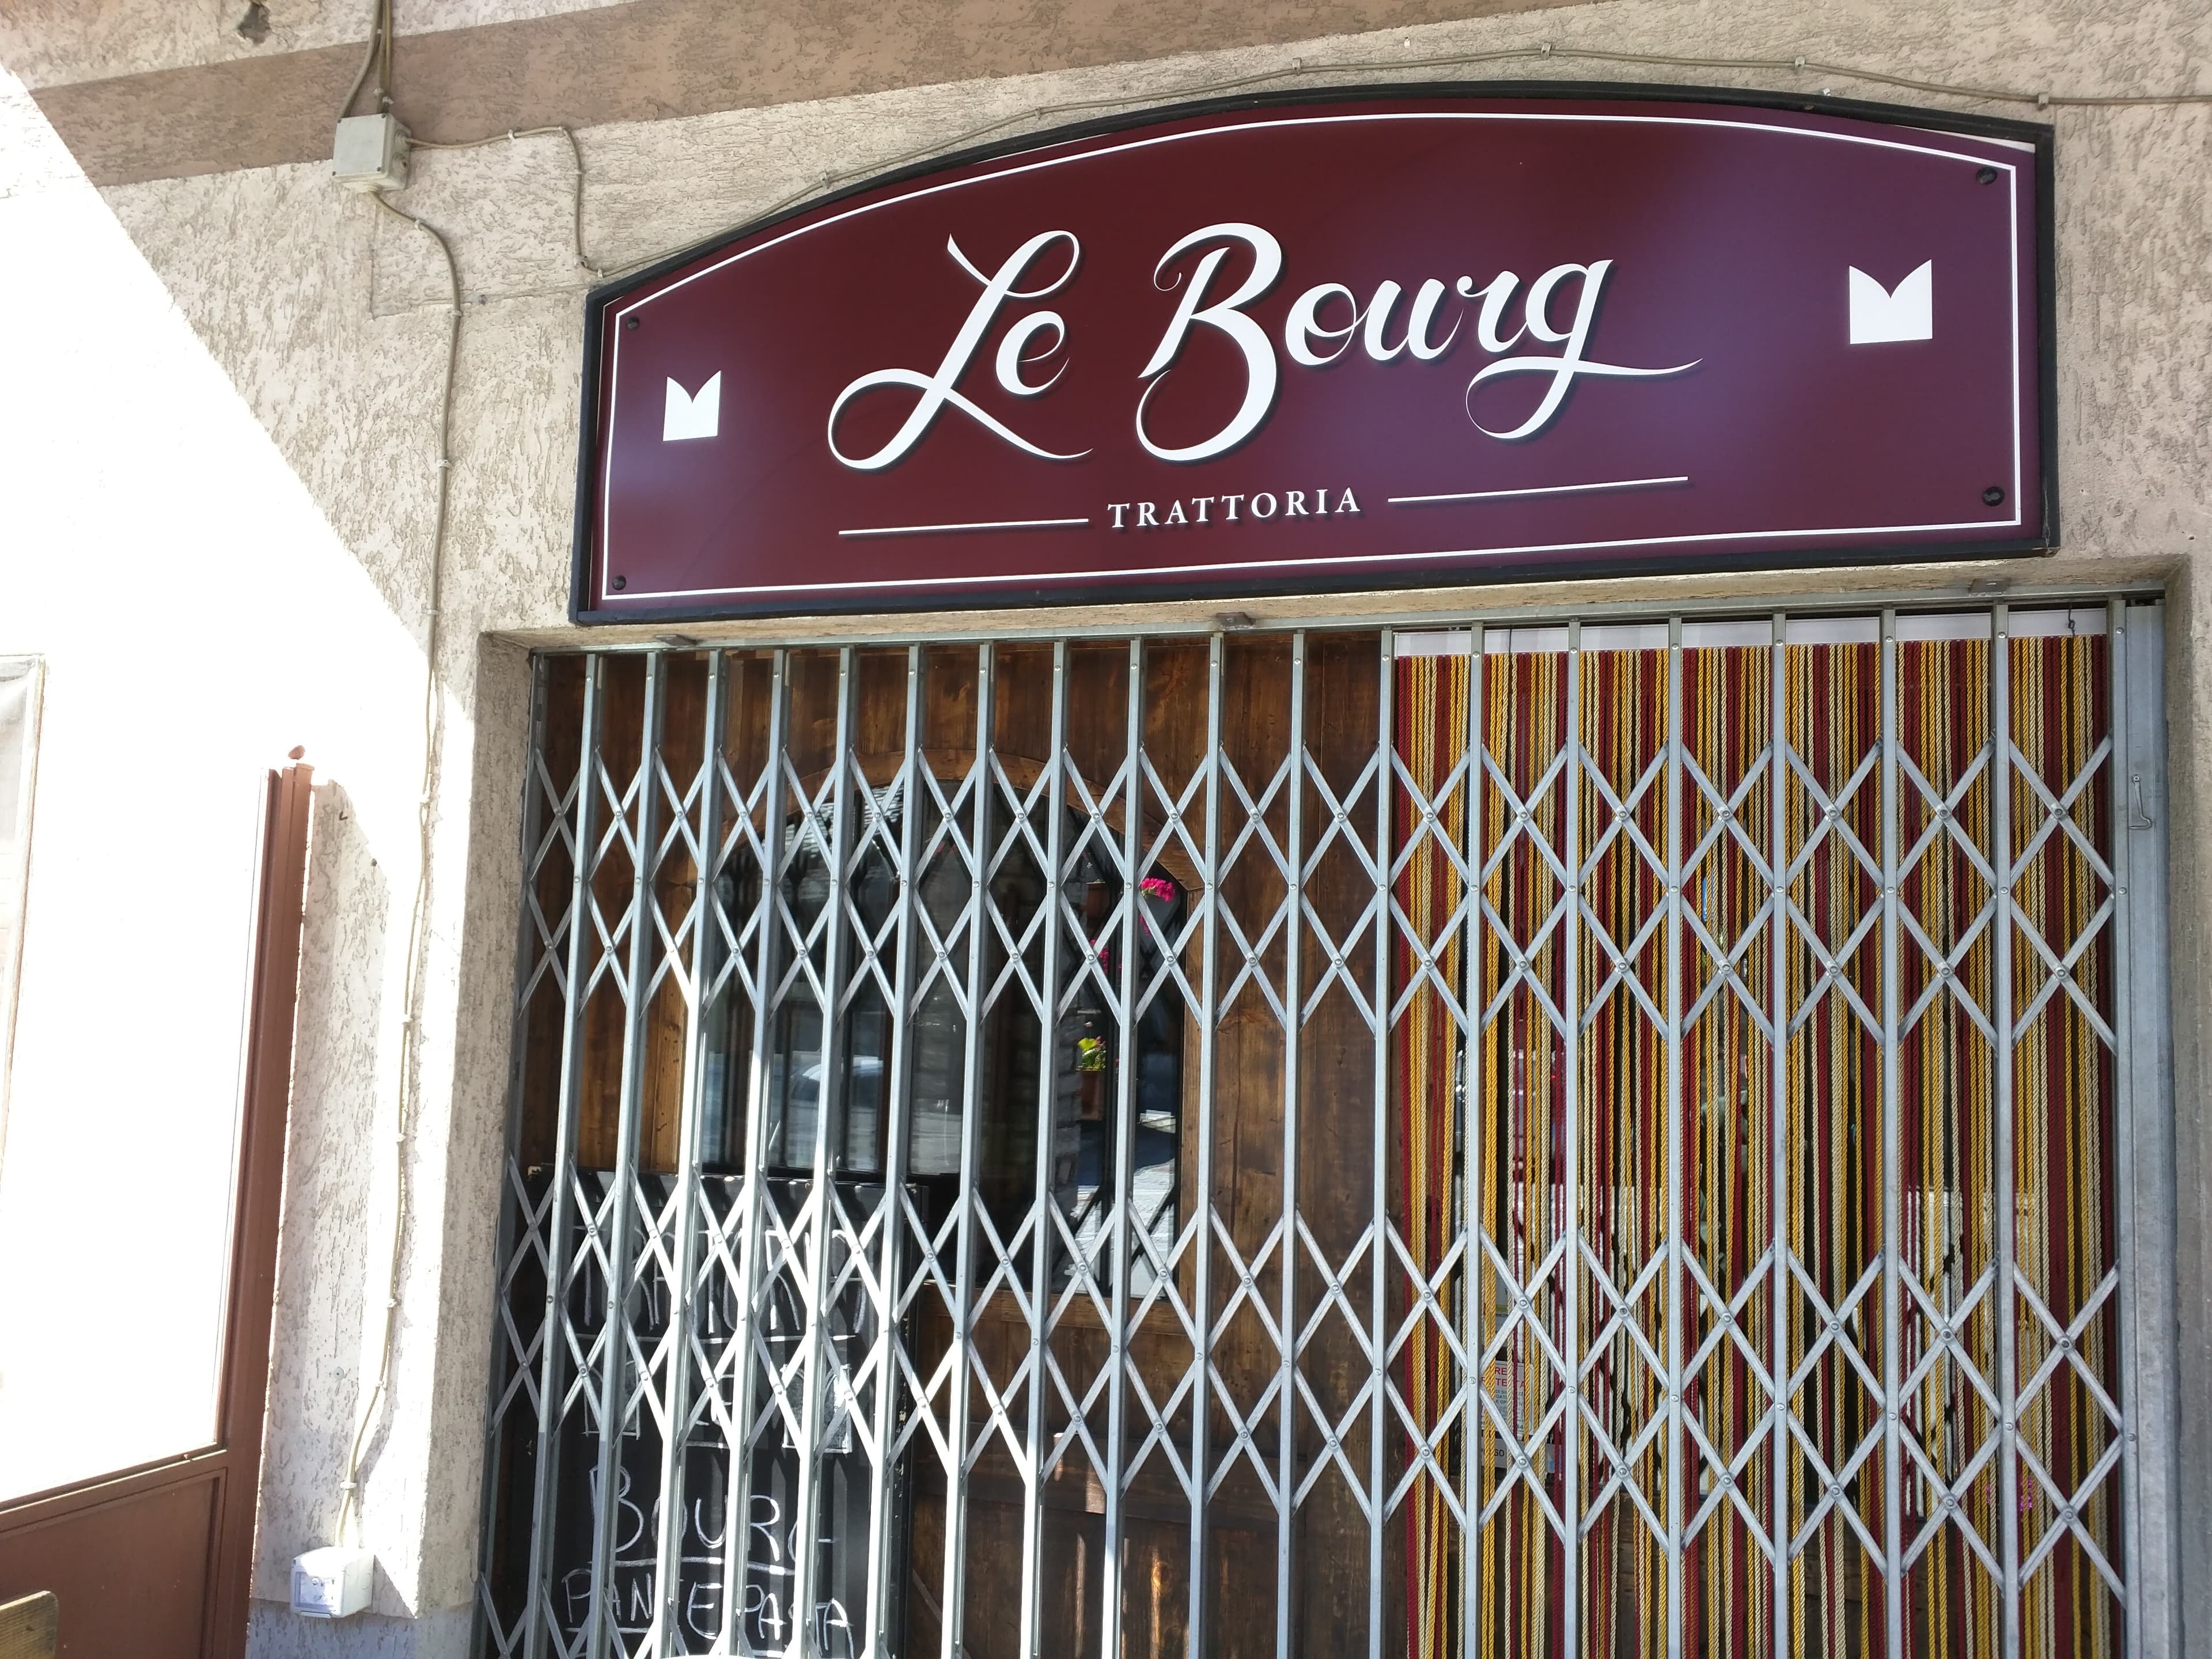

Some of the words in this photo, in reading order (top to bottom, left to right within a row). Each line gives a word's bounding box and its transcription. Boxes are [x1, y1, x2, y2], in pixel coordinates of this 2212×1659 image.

[828, 230, 1093, 471] Le
[1137, 222, 1703, 461] Bourg
[1107, 486, 1361, 529] TRATTORIA
